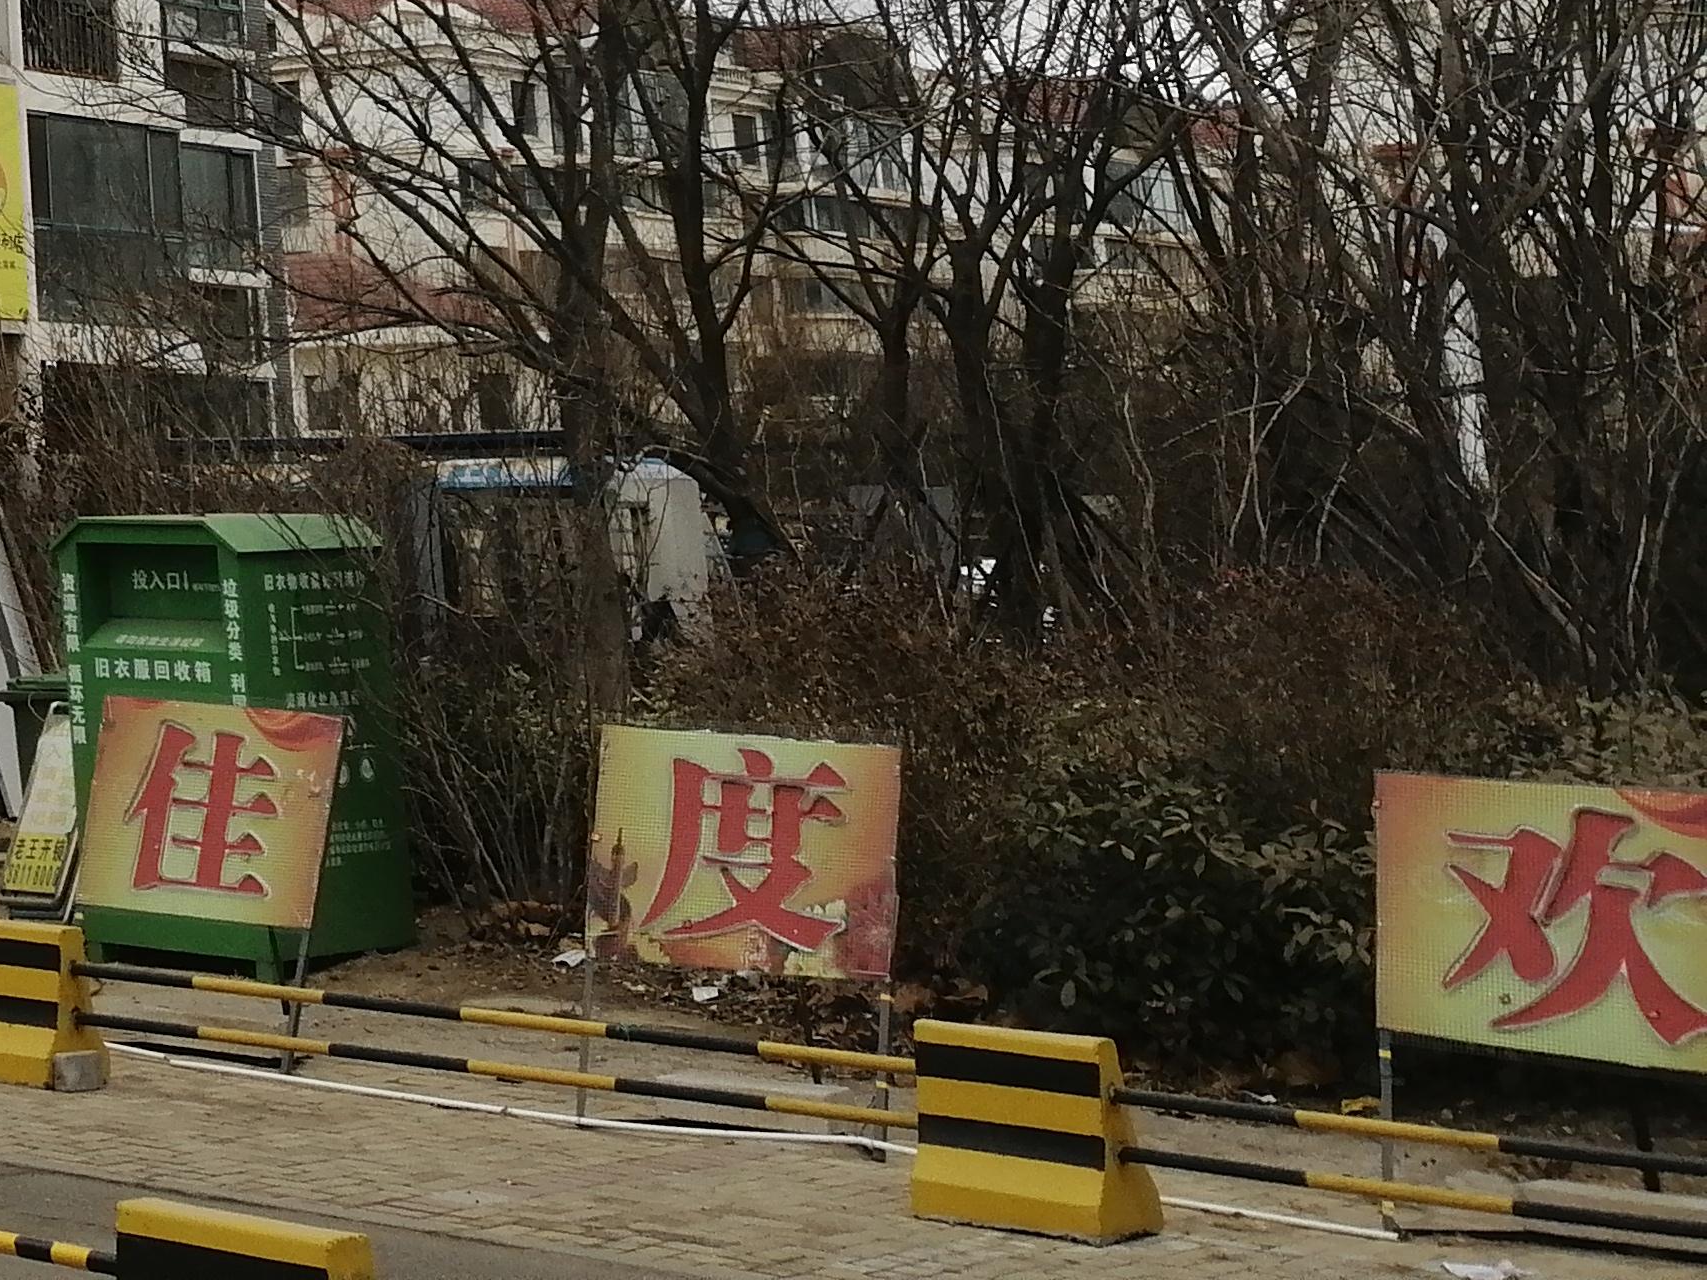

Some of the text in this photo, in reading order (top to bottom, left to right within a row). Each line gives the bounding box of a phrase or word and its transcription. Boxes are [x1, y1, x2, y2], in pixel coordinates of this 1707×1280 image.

[94, 657, 212, 683] 旧衣服回收箱
[222, 578, 244, 662] 垃圾分类
[125, 720, 283, 896] 佳
[639, 747, 850, 954] 度
[1443, 806, 1707, 1046] 欢
